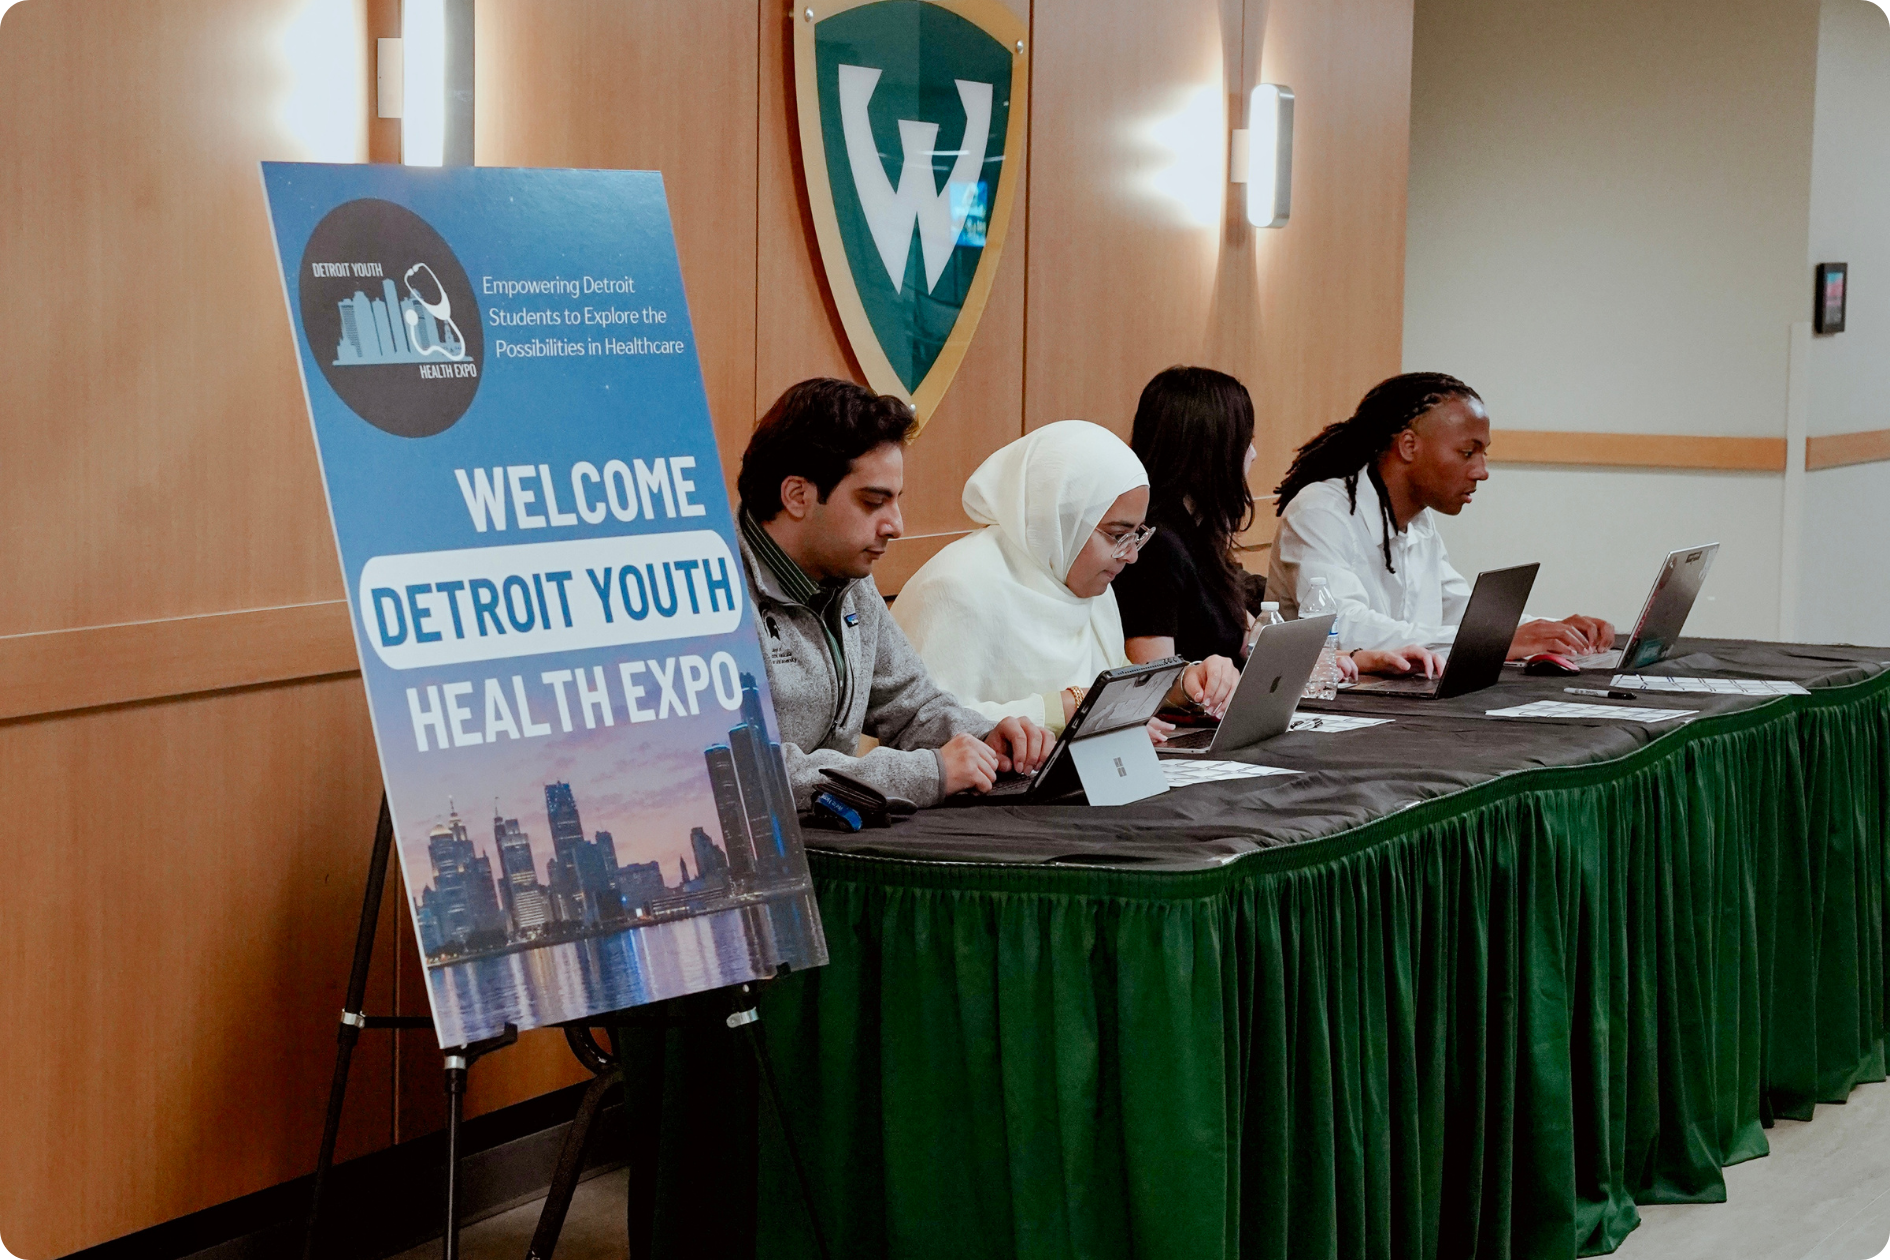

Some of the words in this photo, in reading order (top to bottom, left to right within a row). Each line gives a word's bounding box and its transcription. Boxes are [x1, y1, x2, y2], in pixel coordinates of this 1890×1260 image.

[838, 63, 993, 296] W
[312, 262, 350, 277] DETROIT
[351, 262, 383, 277] YOUTH
[482, 276, 580, 298] Empowering
[583, 276, 635, 294] Detroit
[489, 307, 561, 326] Students
[564, 308, 581, 325] to
[584, 306, 639, 328] Explore
[642, 306, 667, 324] the
[495, 338, 585, 358] Possibilities
[588, 338, 601, 355] in
[605, 337, 684, 355] Healthcare
[419, 364, 453, 379] HEALTH
[454, 363, 477, 378] EXPO
[454, 456, 706, 533] WELCOME
[371, 571, 574, 648] DETROIT
[586, 557, 736, 624] YOUTH
[406, 665, 614, 752] HEALTH
[619, 651, 744, 724] EXPO
